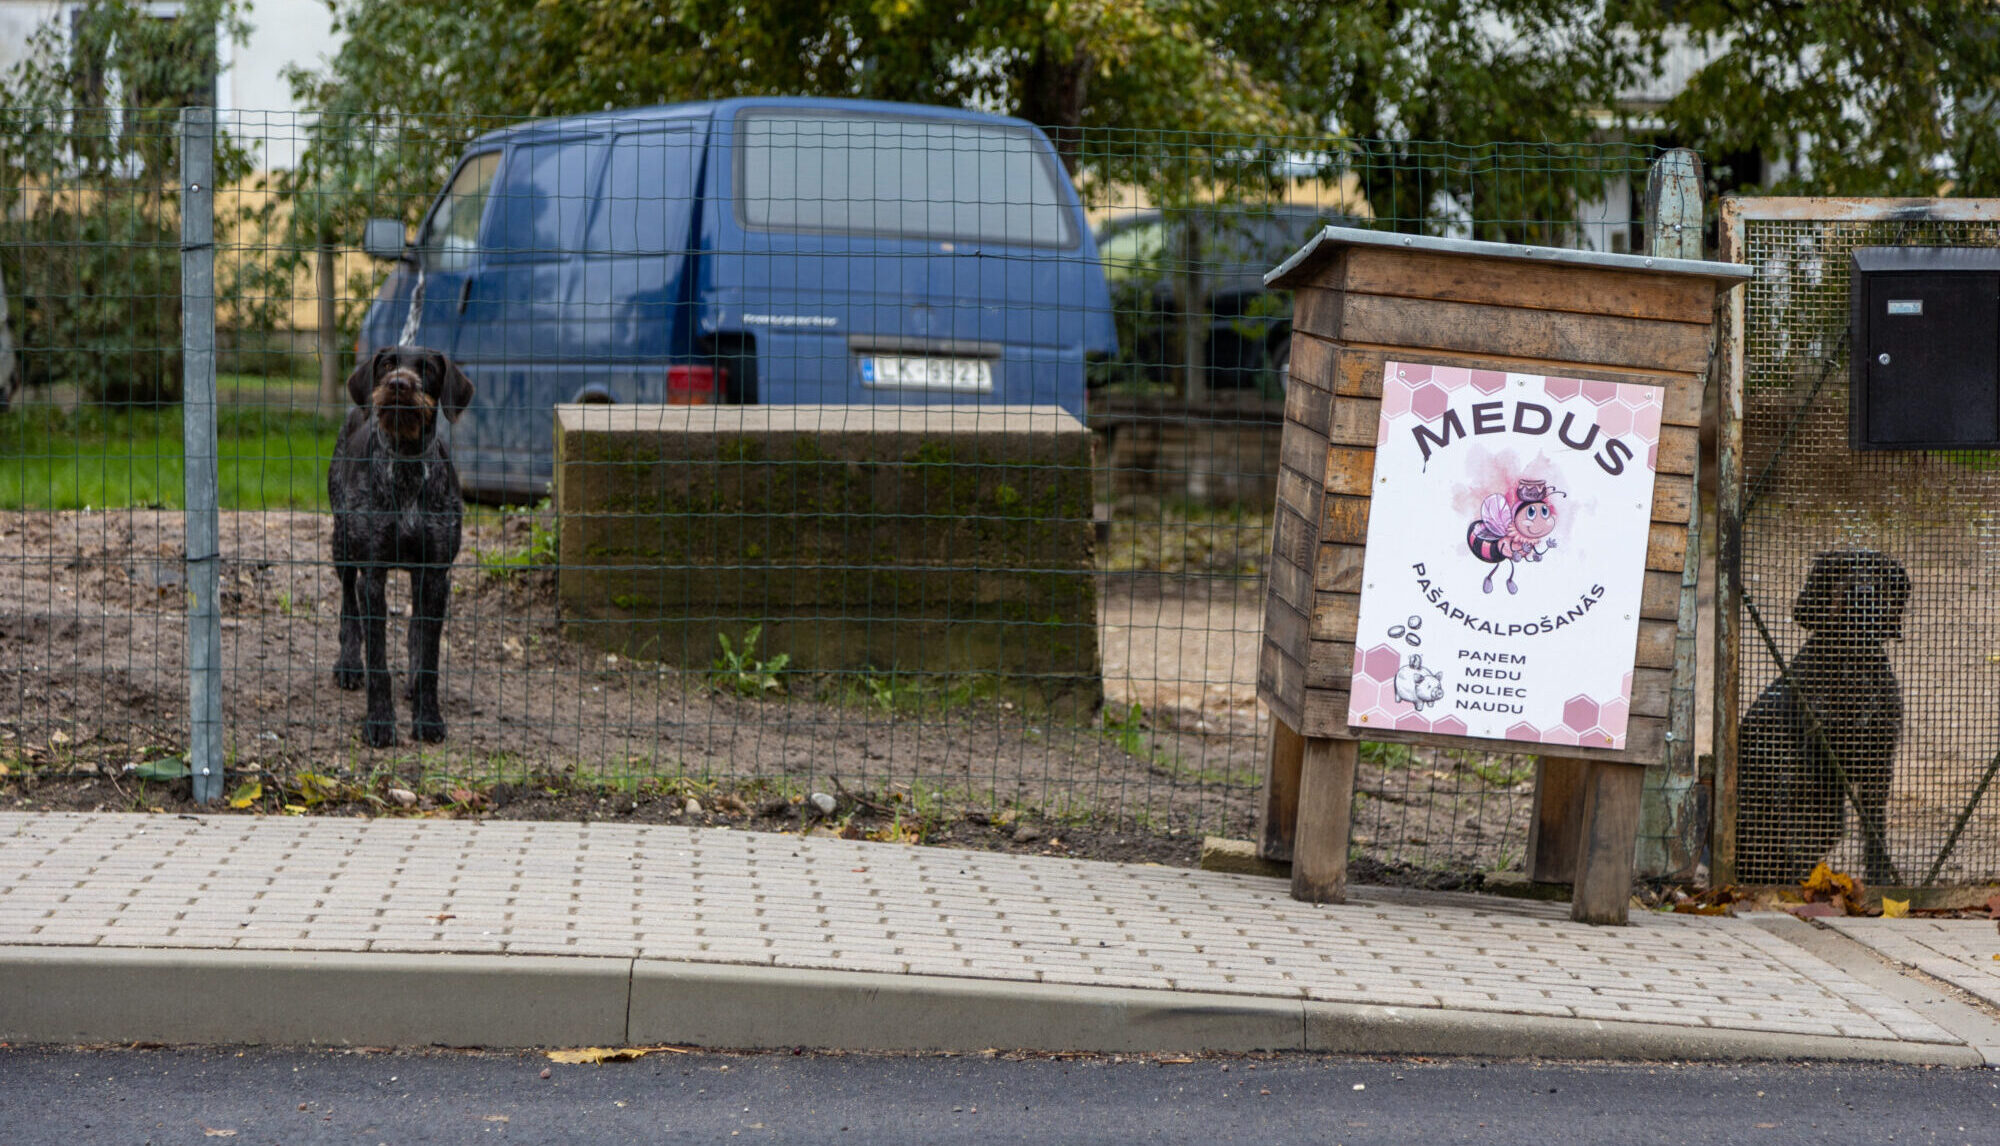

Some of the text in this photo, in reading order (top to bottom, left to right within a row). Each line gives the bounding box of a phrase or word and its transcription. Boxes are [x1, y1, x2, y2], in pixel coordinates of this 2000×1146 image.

[1411, 400, 1634, 476] MEDUS
[1412, 562, 1605, 637] PAŠAPKALPOŠANĀS
[1458, 649, 1526, 665] PAŅEM
[1465, 667, 1521, 681] MEDU
[1456, 683, 1527, 698] NOLIEC
[1455, 700, 1524, 714] NAUDU
